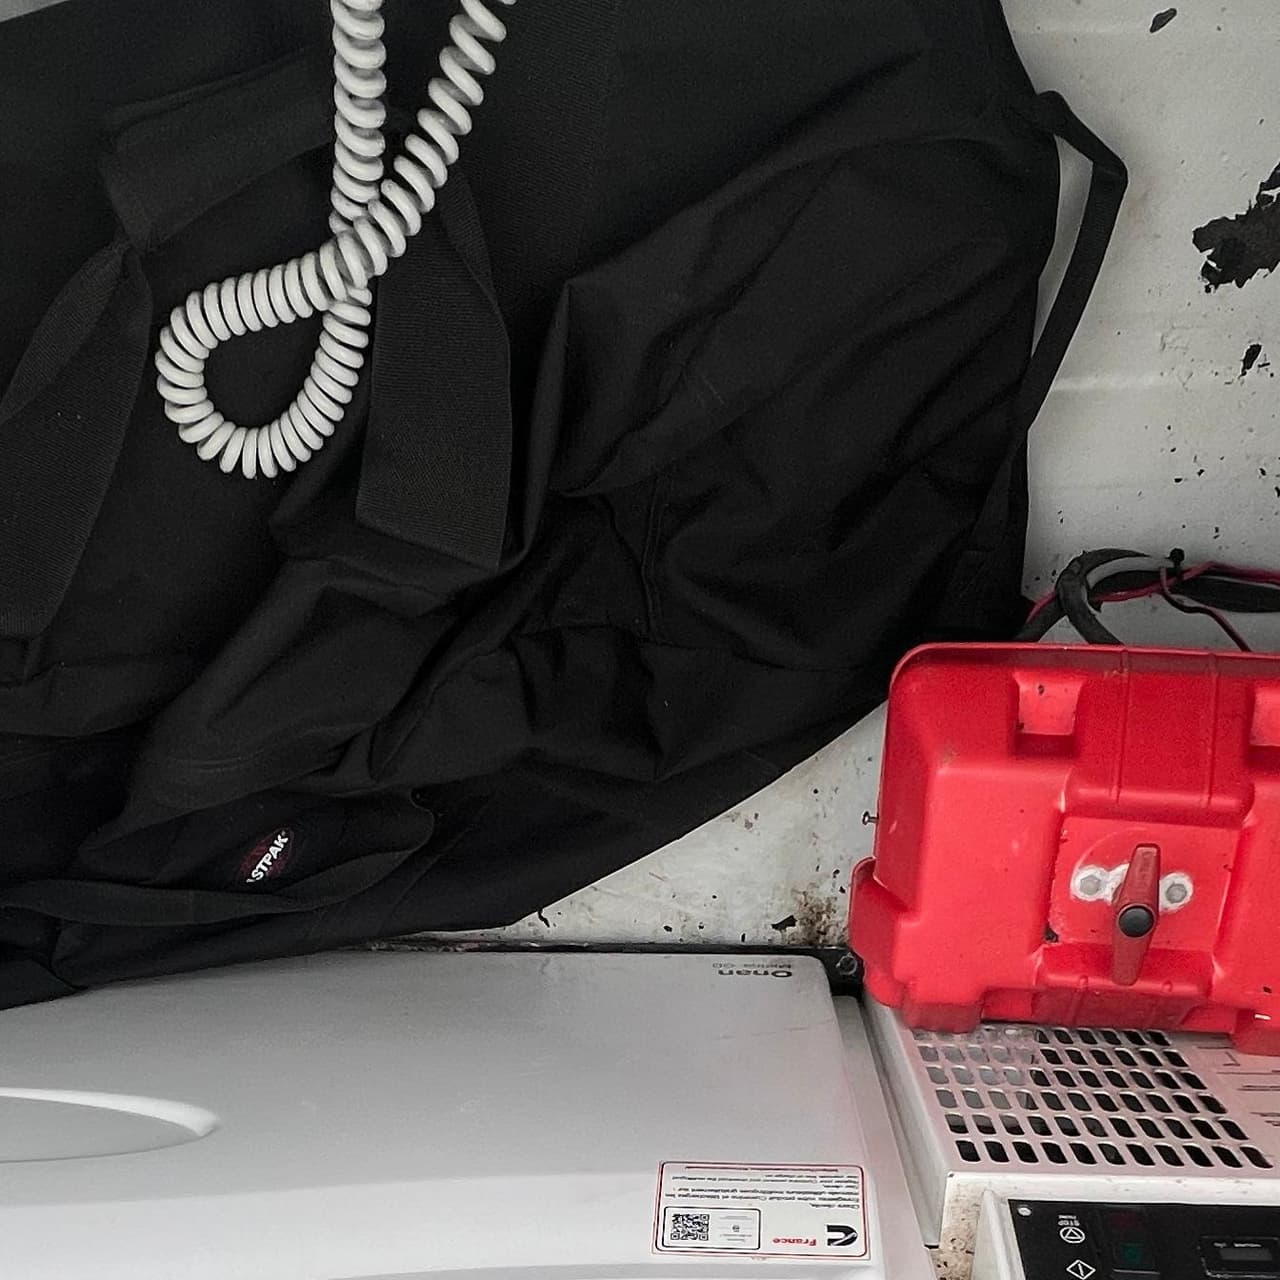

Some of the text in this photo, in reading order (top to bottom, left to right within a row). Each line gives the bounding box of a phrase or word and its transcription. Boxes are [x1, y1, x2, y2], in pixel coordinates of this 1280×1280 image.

[246, 833, 289, 883] STPAK
[718, 970, 792, 978] Onan
[772, 1238, 816, 1246] France
